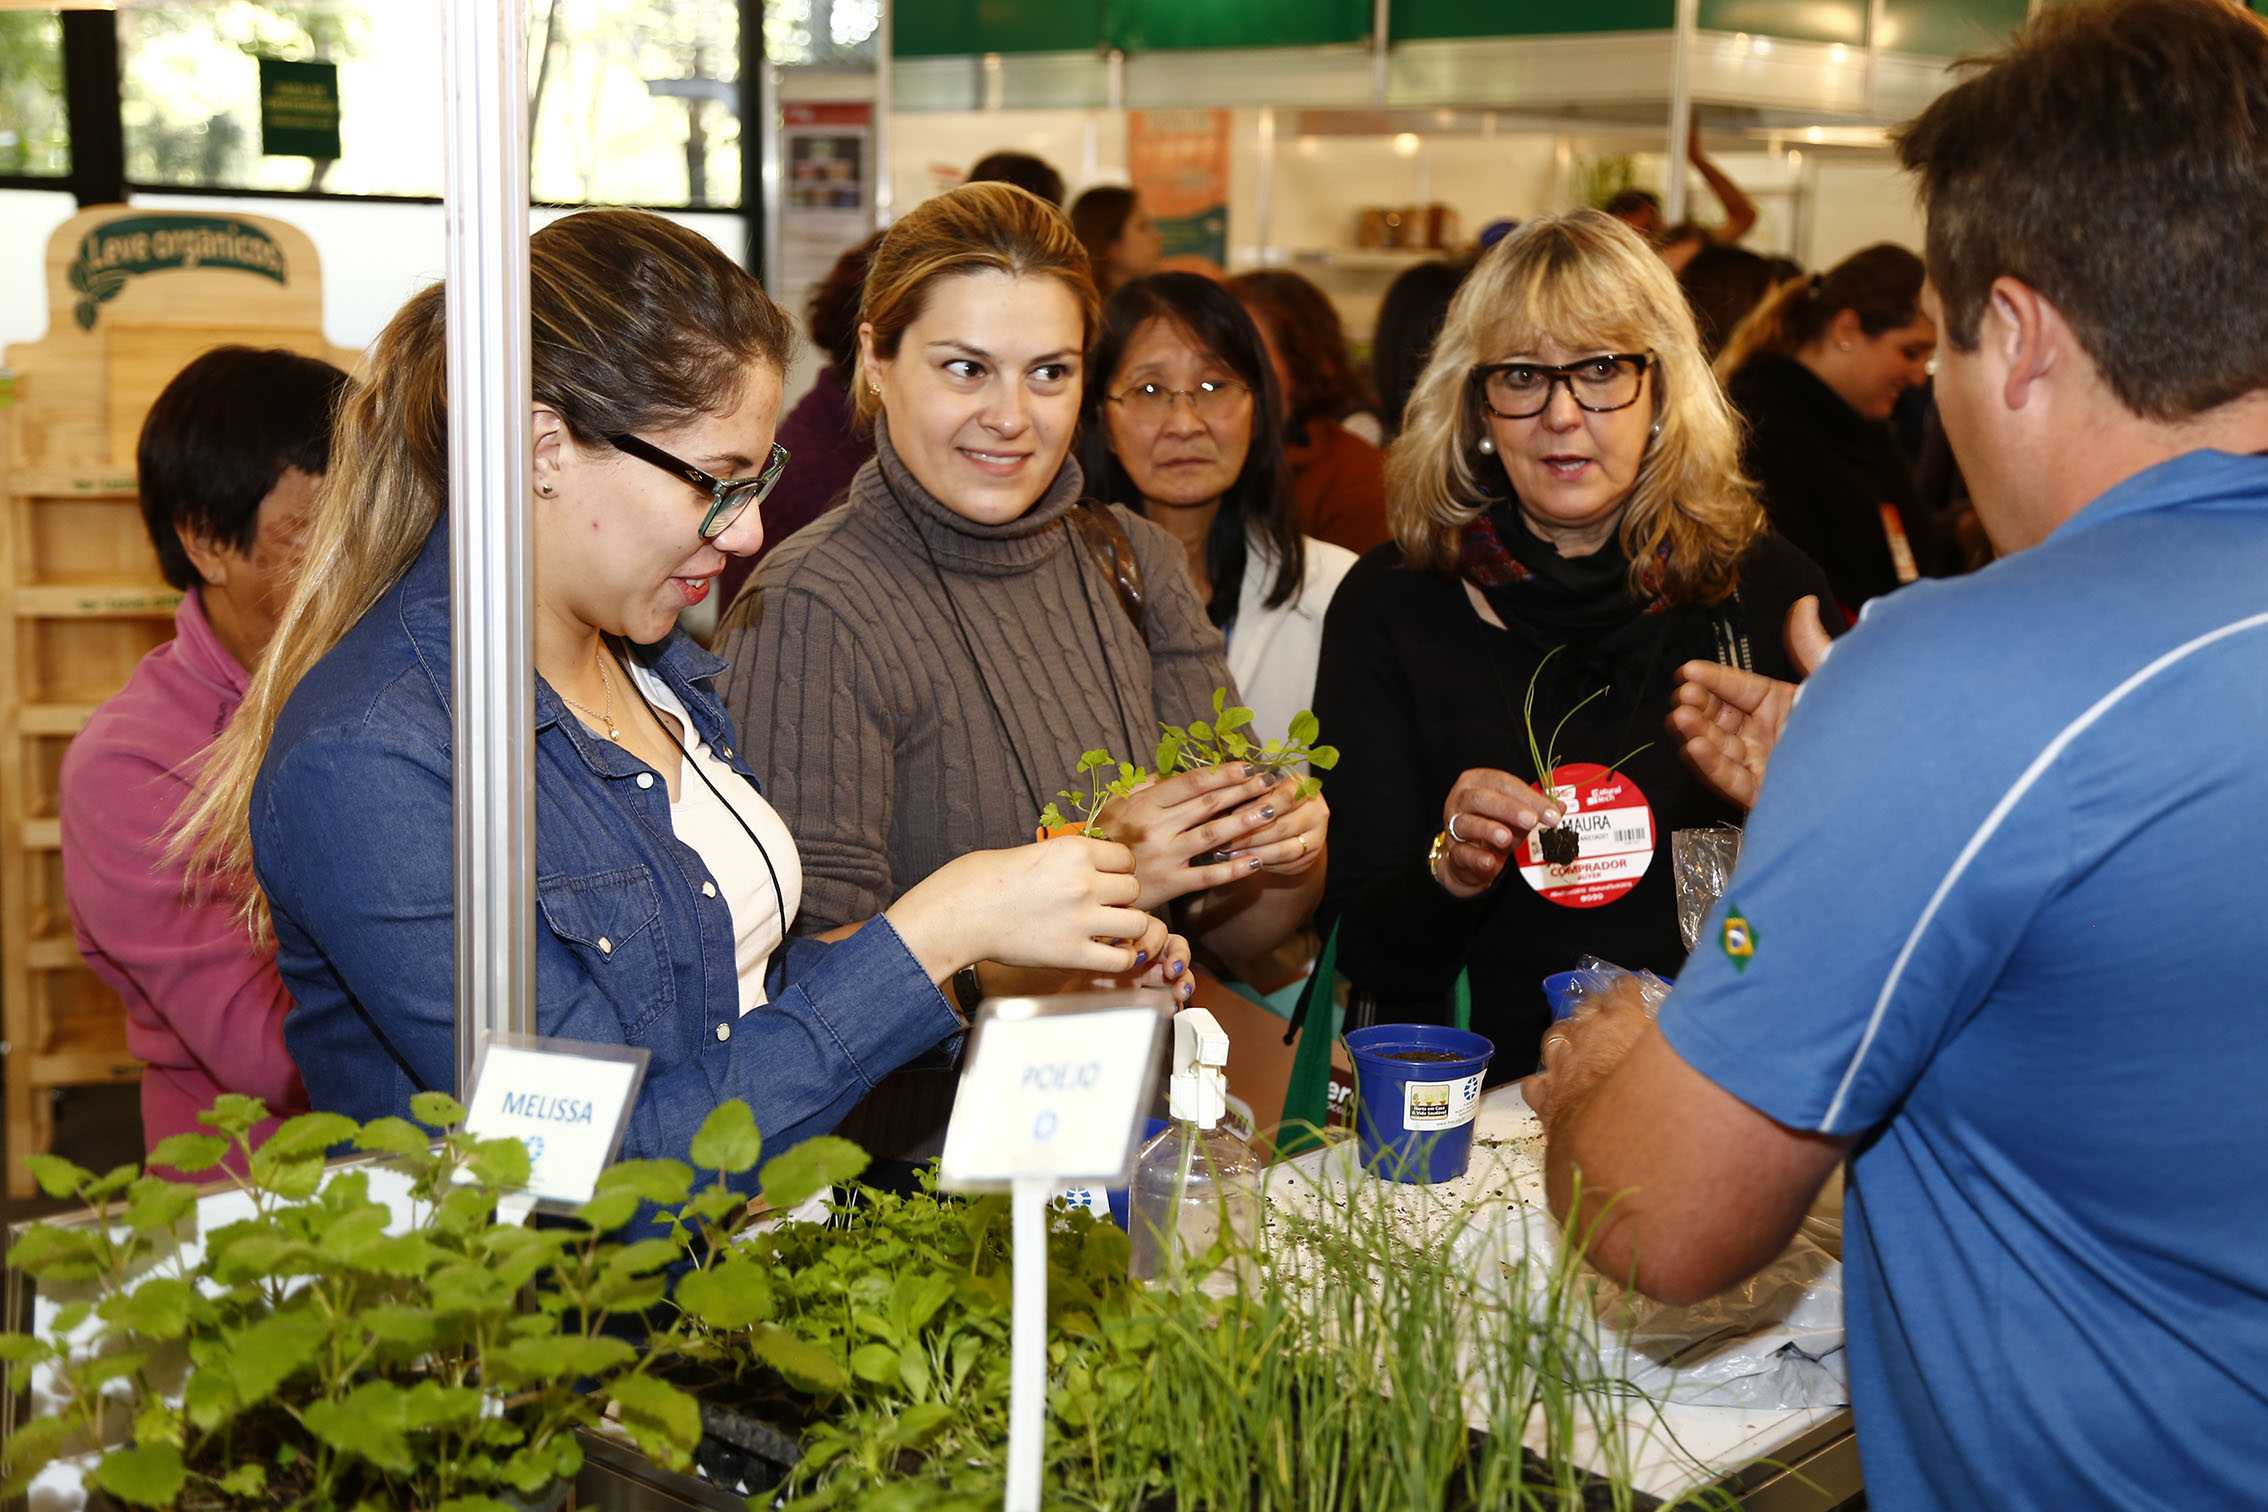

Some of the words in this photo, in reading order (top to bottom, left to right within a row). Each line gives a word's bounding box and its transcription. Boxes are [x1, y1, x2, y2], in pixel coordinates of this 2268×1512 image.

[88, 231, 150, 269] Leve
[1562, 815, 1611, 833] MAURA
[1550, 858, 1627, 877] COMPRADOR
[502, 1091, 593, 1124] MELISSA
